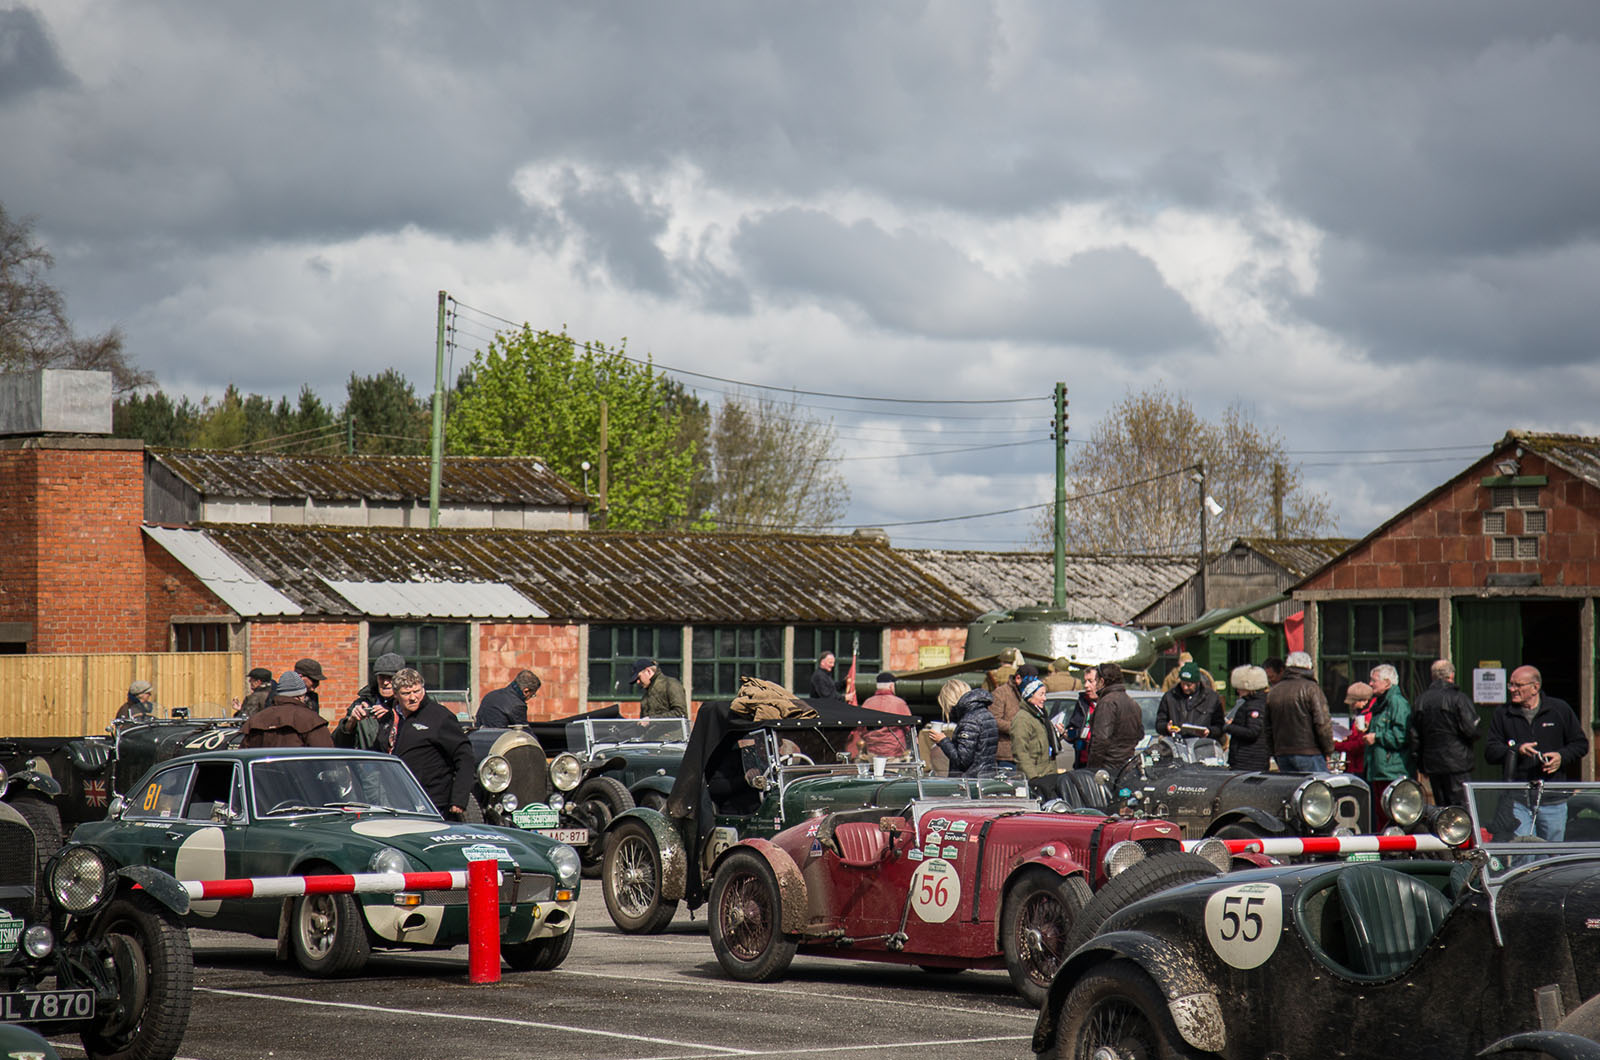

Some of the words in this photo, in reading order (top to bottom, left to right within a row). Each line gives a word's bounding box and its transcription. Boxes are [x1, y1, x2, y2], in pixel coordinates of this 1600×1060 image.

[143, 783, 162, 811] 81
[1177, 785, 1208, 793] RAIDILLON
[539, 832, 586, 841] AAC-871
[944, 834, 967, 842] Bonhams
[919, 875, 949, 907] 56
[1220, 896, 1266, 942] 55
[26, 993, 91, 1018] 7870
